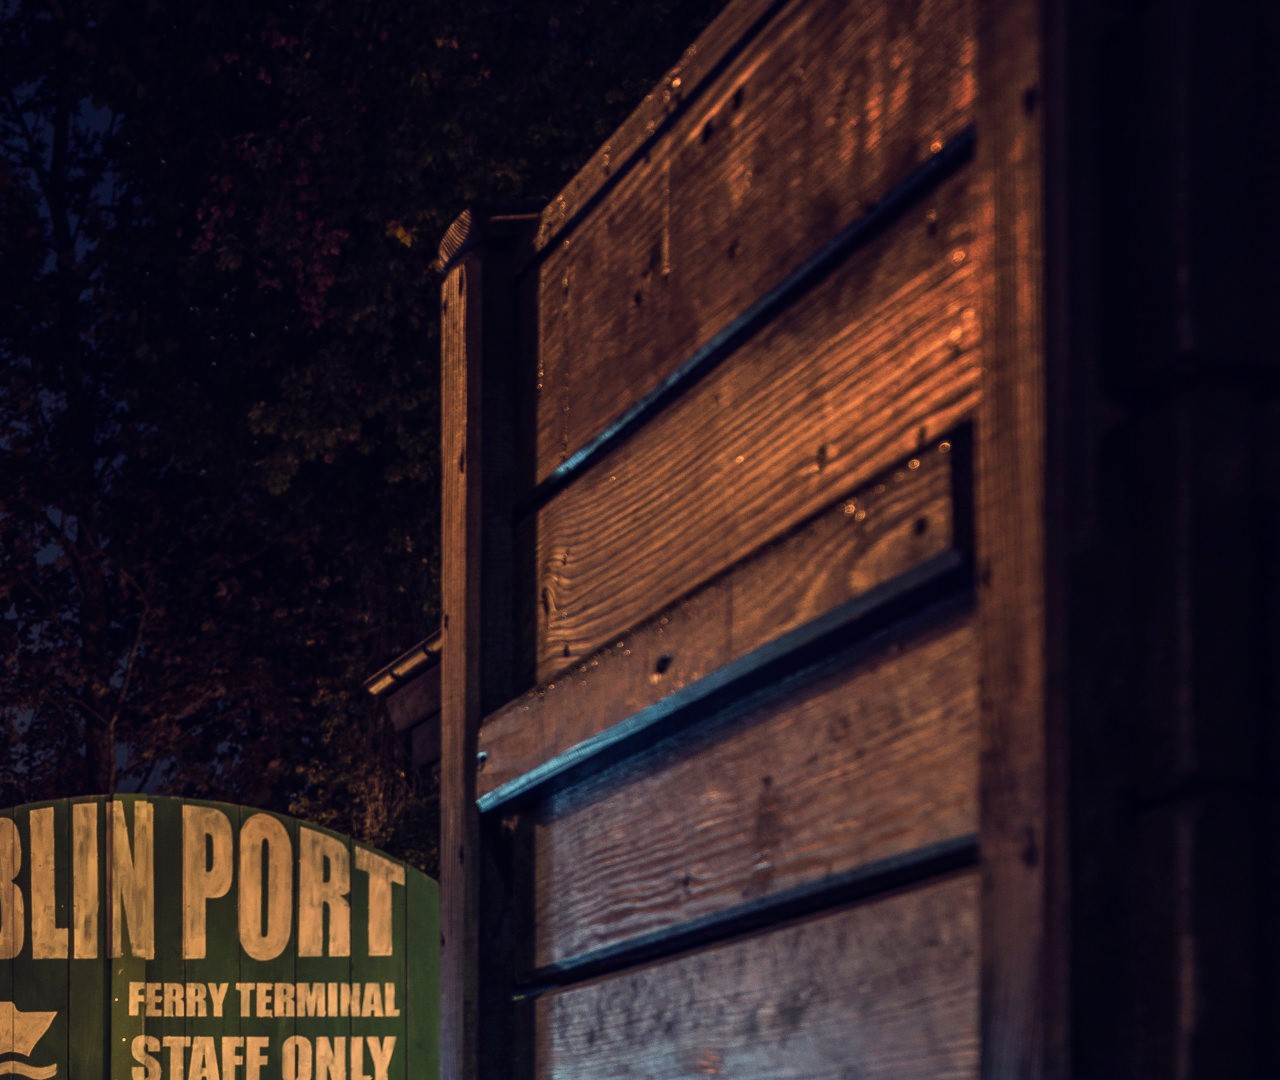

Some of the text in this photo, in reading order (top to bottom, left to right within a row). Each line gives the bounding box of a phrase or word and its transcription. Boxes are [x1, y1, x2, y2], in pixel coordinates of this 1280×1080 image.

[181, 804, 406, 961] PORT
[128, 981, 401, 1018] FERRY TERMINAL
